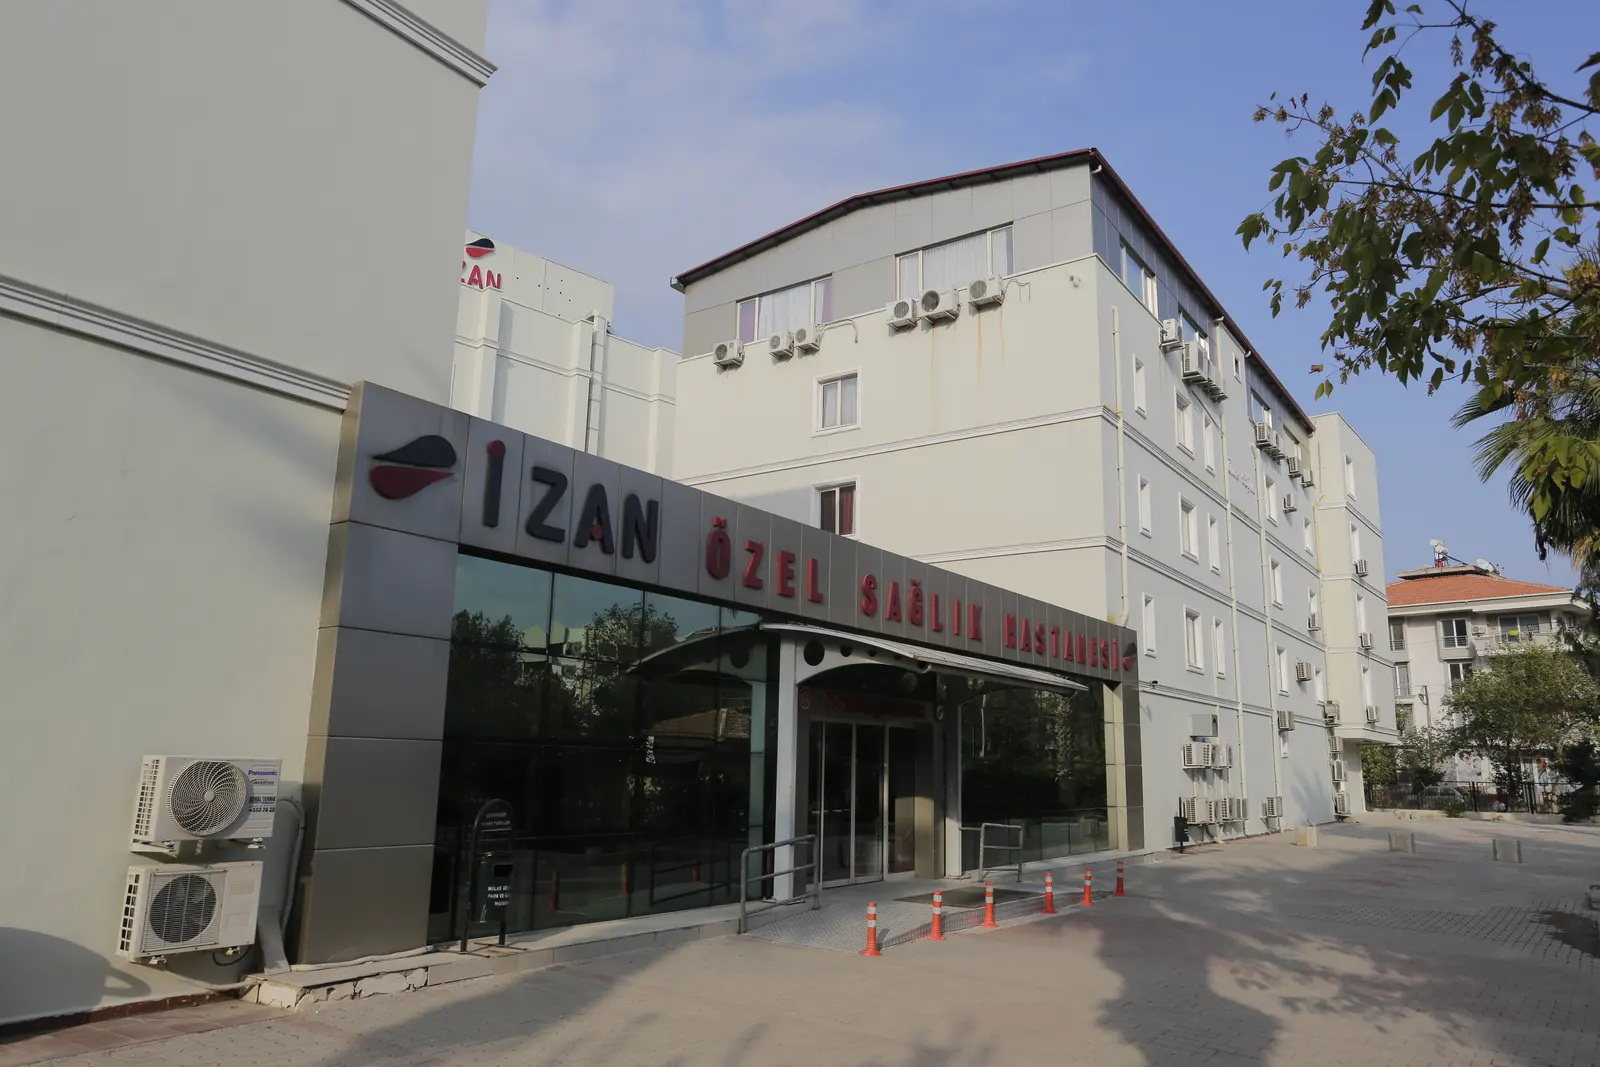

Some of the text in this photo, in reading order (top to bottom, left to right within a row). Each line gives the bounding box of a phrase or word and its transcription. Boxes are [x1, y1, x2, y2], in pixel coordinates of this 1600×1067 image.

[483, 439, 660, 563] İZAN
[705, 516, 1120, 671] ÖZEL SAĞLIK HASTANESİ
